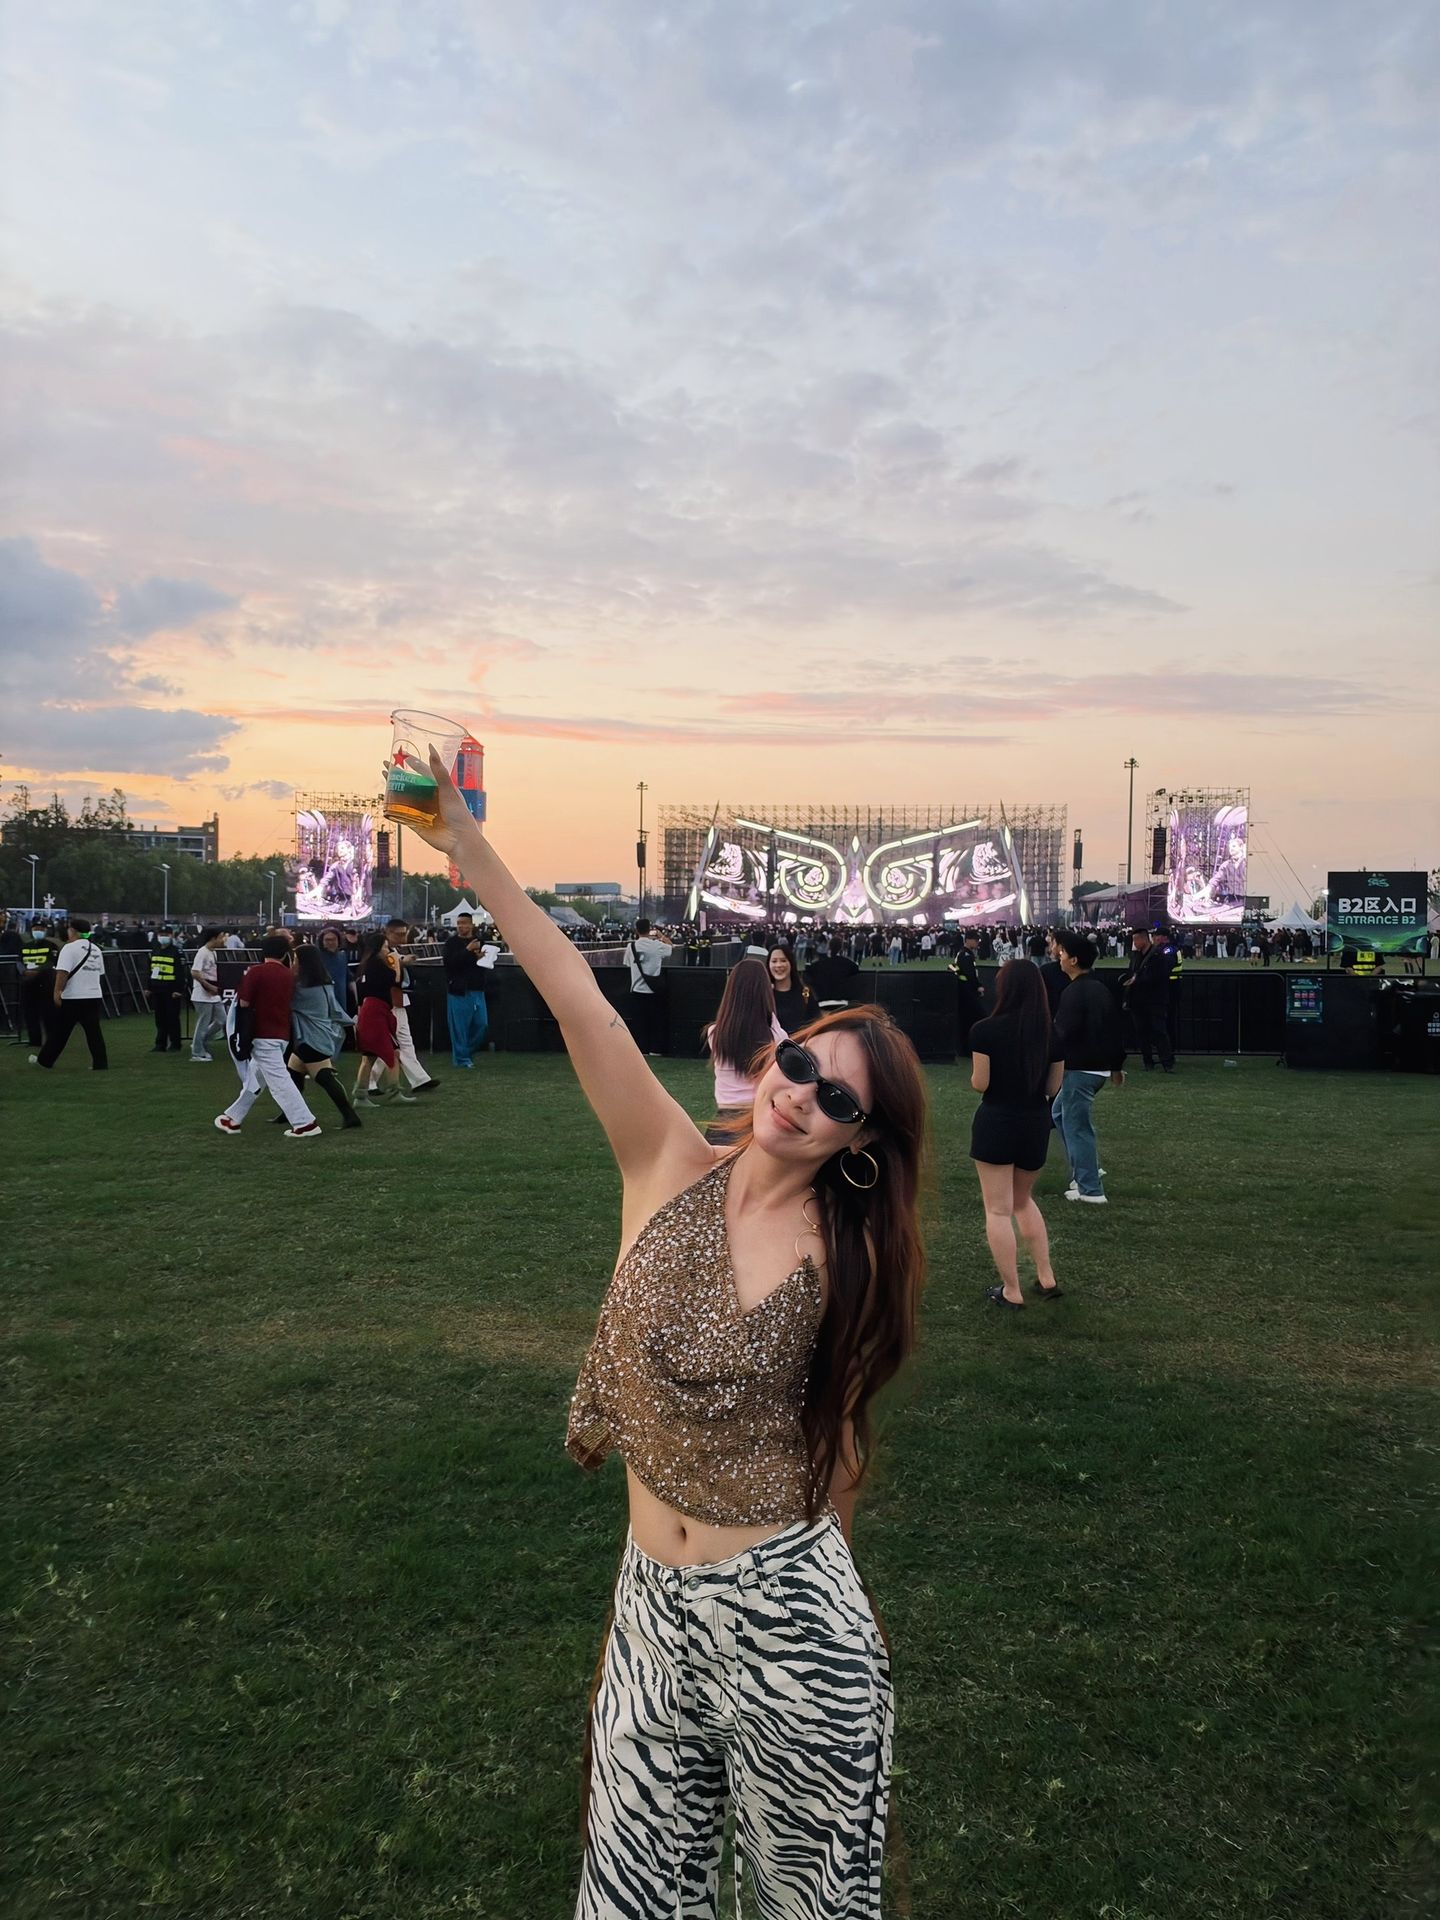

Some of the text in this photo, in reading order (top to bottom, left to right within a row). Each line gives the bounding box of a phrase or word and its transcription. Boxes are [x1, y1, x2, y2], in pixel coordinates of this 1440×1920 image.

[1338, 896, 1417, 914] B2区入口
[1337, 915, 1416, 925] ENTRANCE B2
